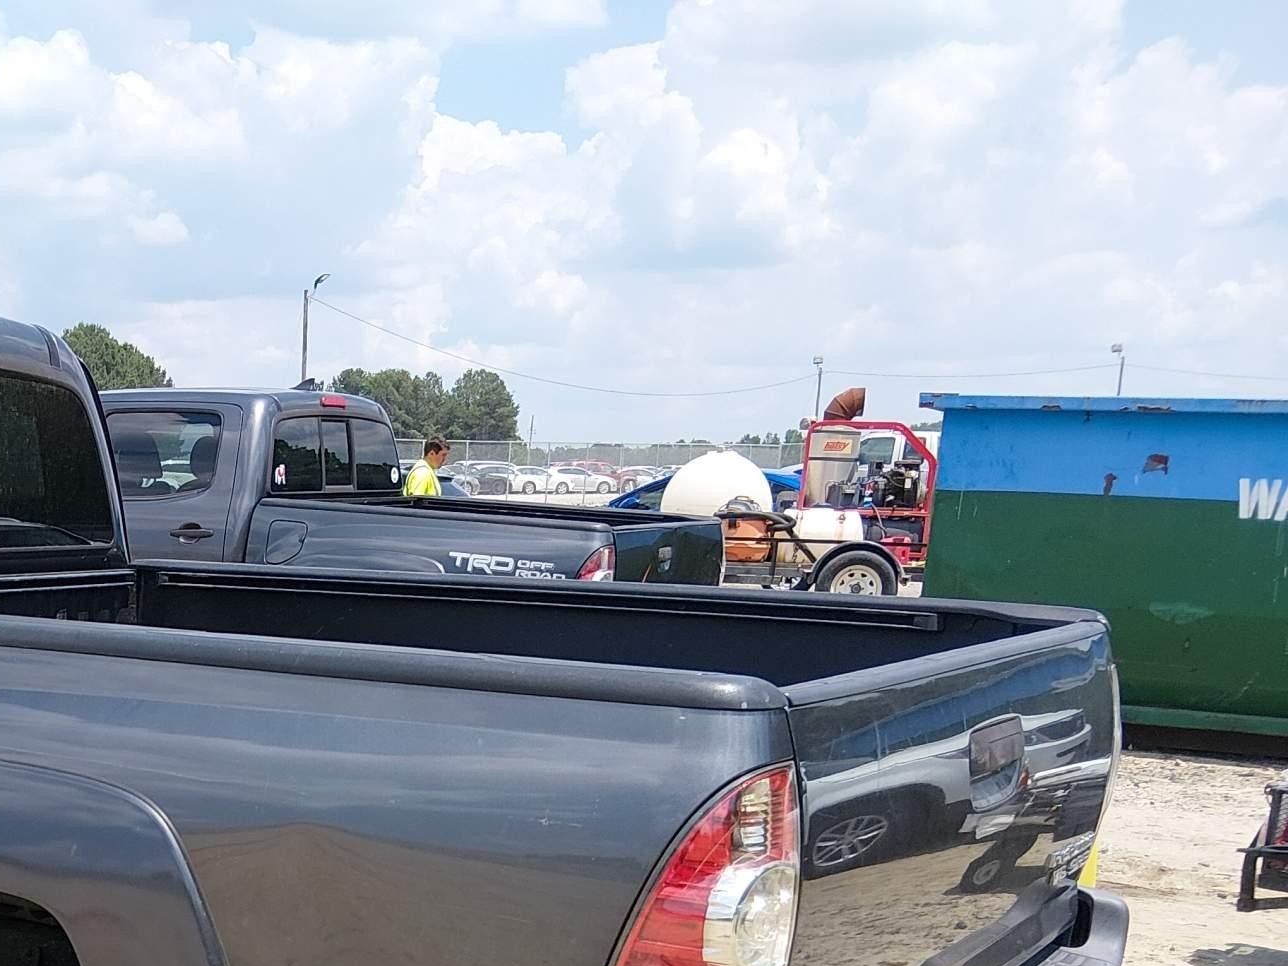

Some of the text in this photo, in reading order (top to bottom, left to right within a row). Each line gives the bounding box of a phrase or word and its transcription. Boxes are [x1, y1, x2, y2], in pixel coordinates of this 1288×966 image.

[448, 551, 554, 575] TRD OFF
[515, 571, 566, 580] ROAD
